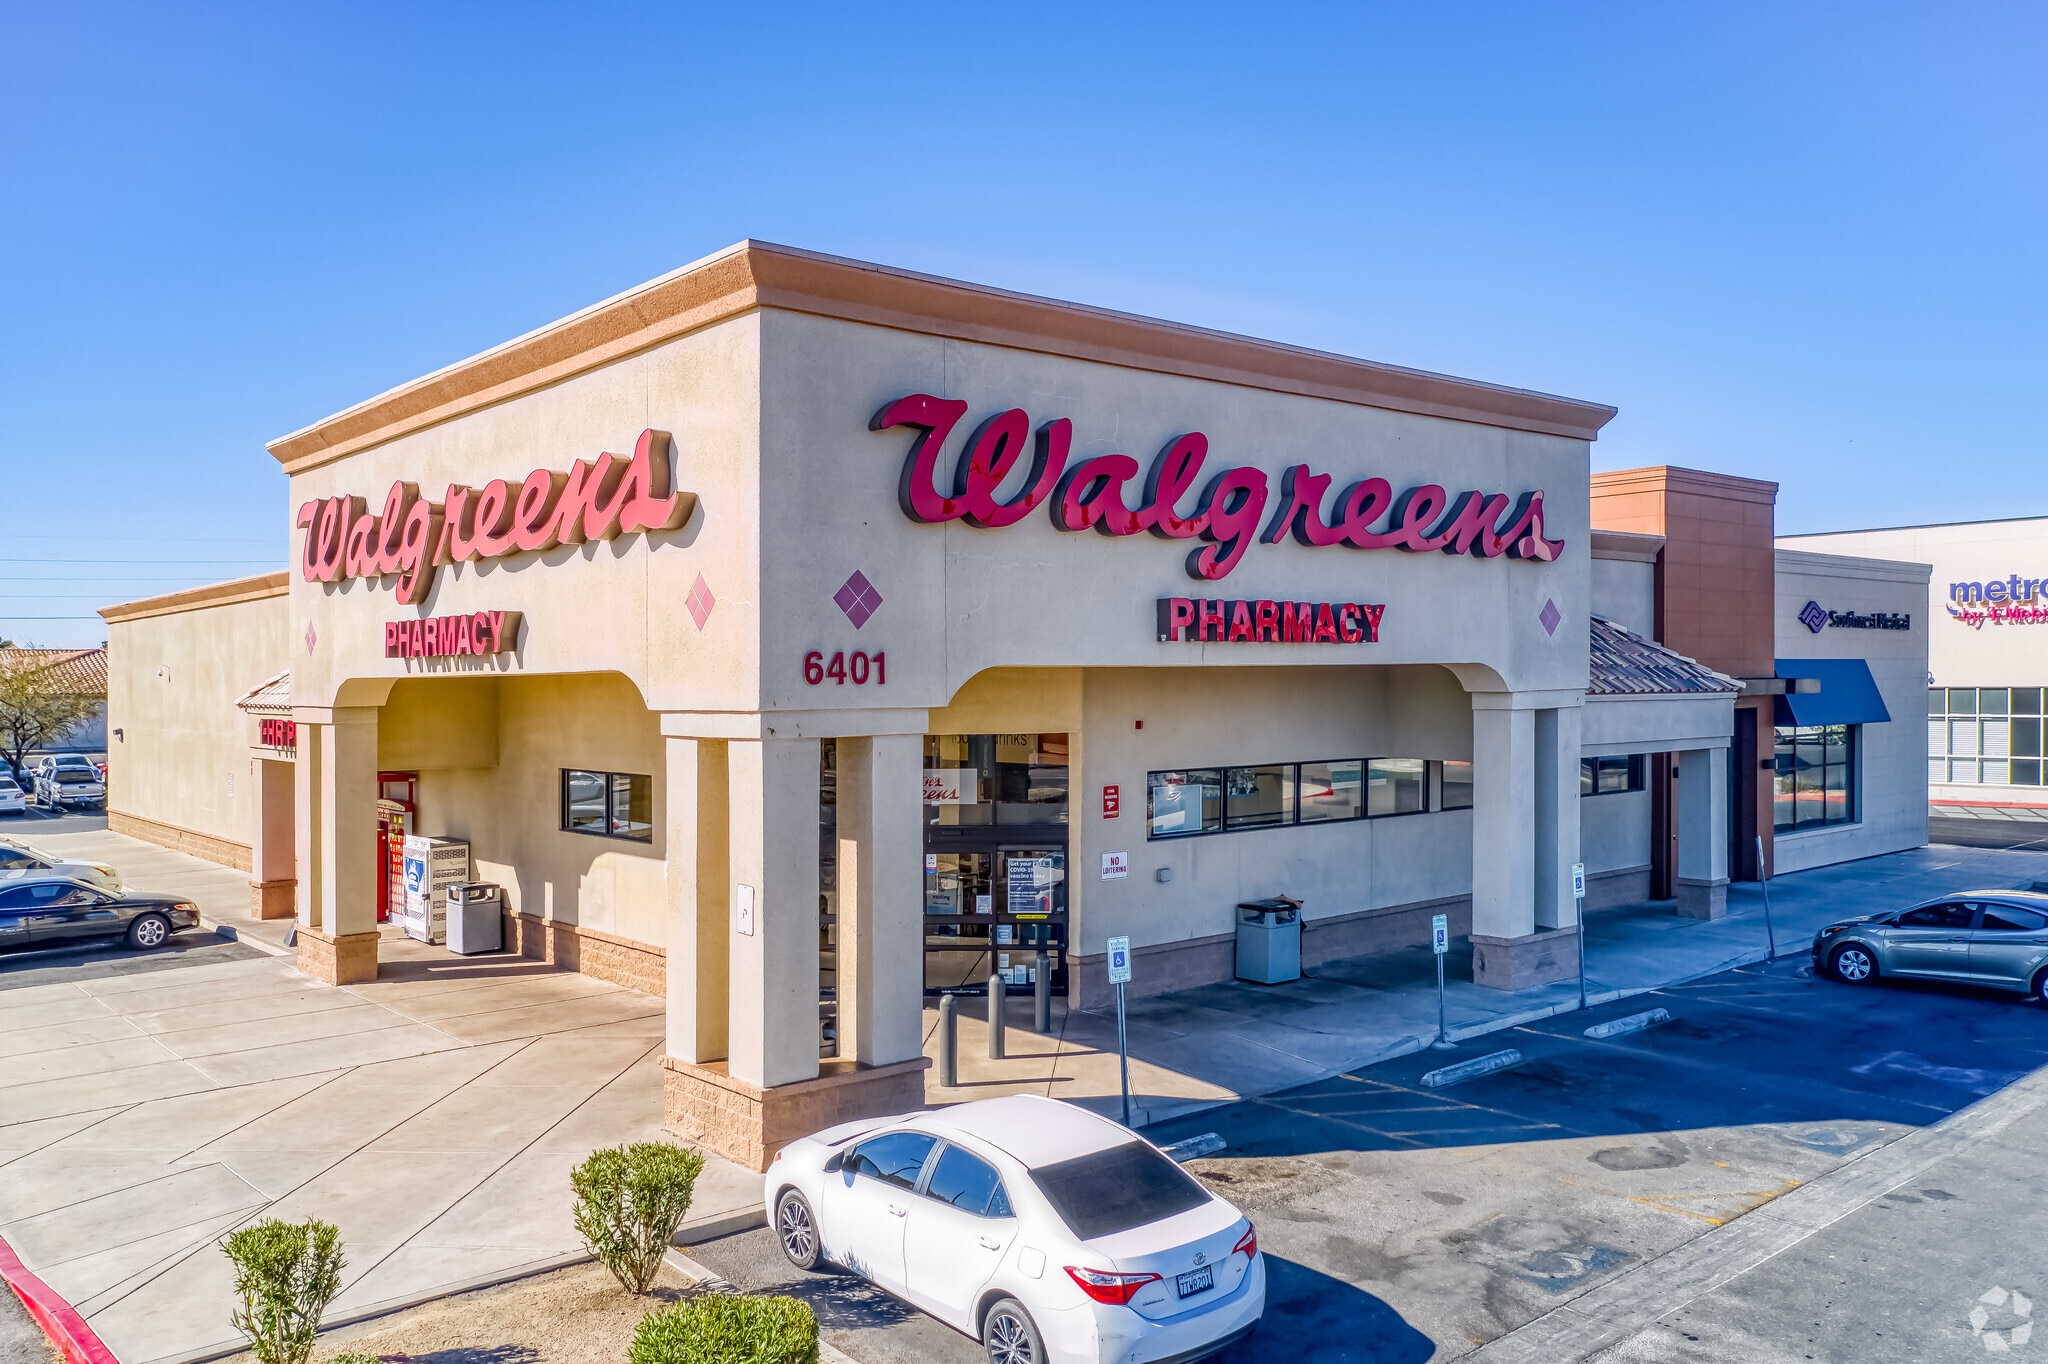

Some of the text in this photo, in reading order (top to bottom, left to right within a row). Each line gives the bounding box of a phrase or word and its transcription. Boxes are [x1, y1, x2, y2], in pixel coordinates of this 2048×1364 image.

[870, 394, 1564, 580] Walgreens
[297, 428, 684, 605] Walgreens
[385, 611, 509, 659] PHARMACY
[1167, 598, 1386, 644] PHARMACY
[1828, 610, 1911, 631] Southwest Medical
[804, 651, 886, 685] 6401
[1102, 865, 1127, 875] LOITERING
[1110, 856, 1120, 865] NO
